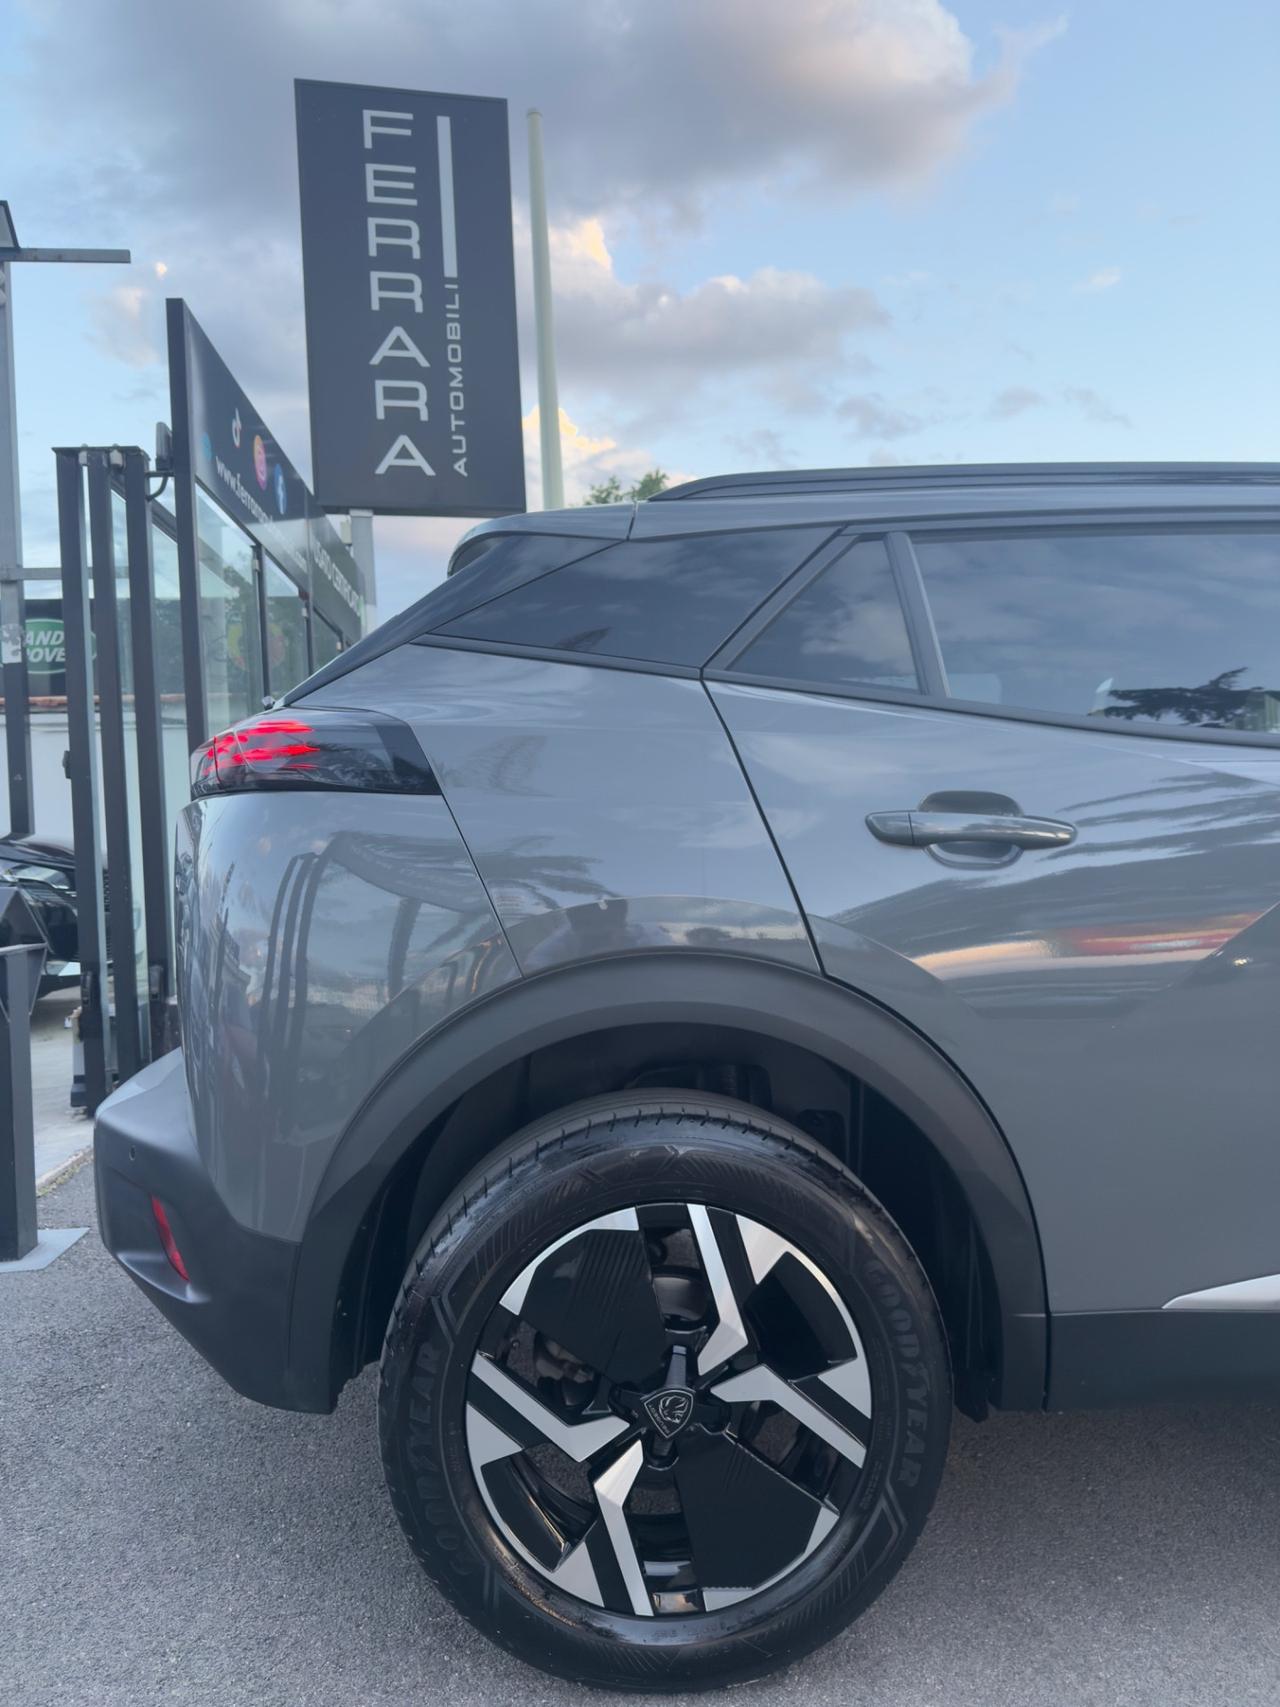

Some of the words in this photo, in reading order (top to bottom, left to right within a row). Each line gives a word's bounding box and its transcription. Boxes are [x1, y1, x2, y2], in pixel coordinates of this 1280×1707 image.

[362, 109, 436, 476] FERRARA
[444, 284, 468, 477] AUTOMOBILI
[23, 630, 64, 646] AND
[27, 647, 66, 663] OVE
